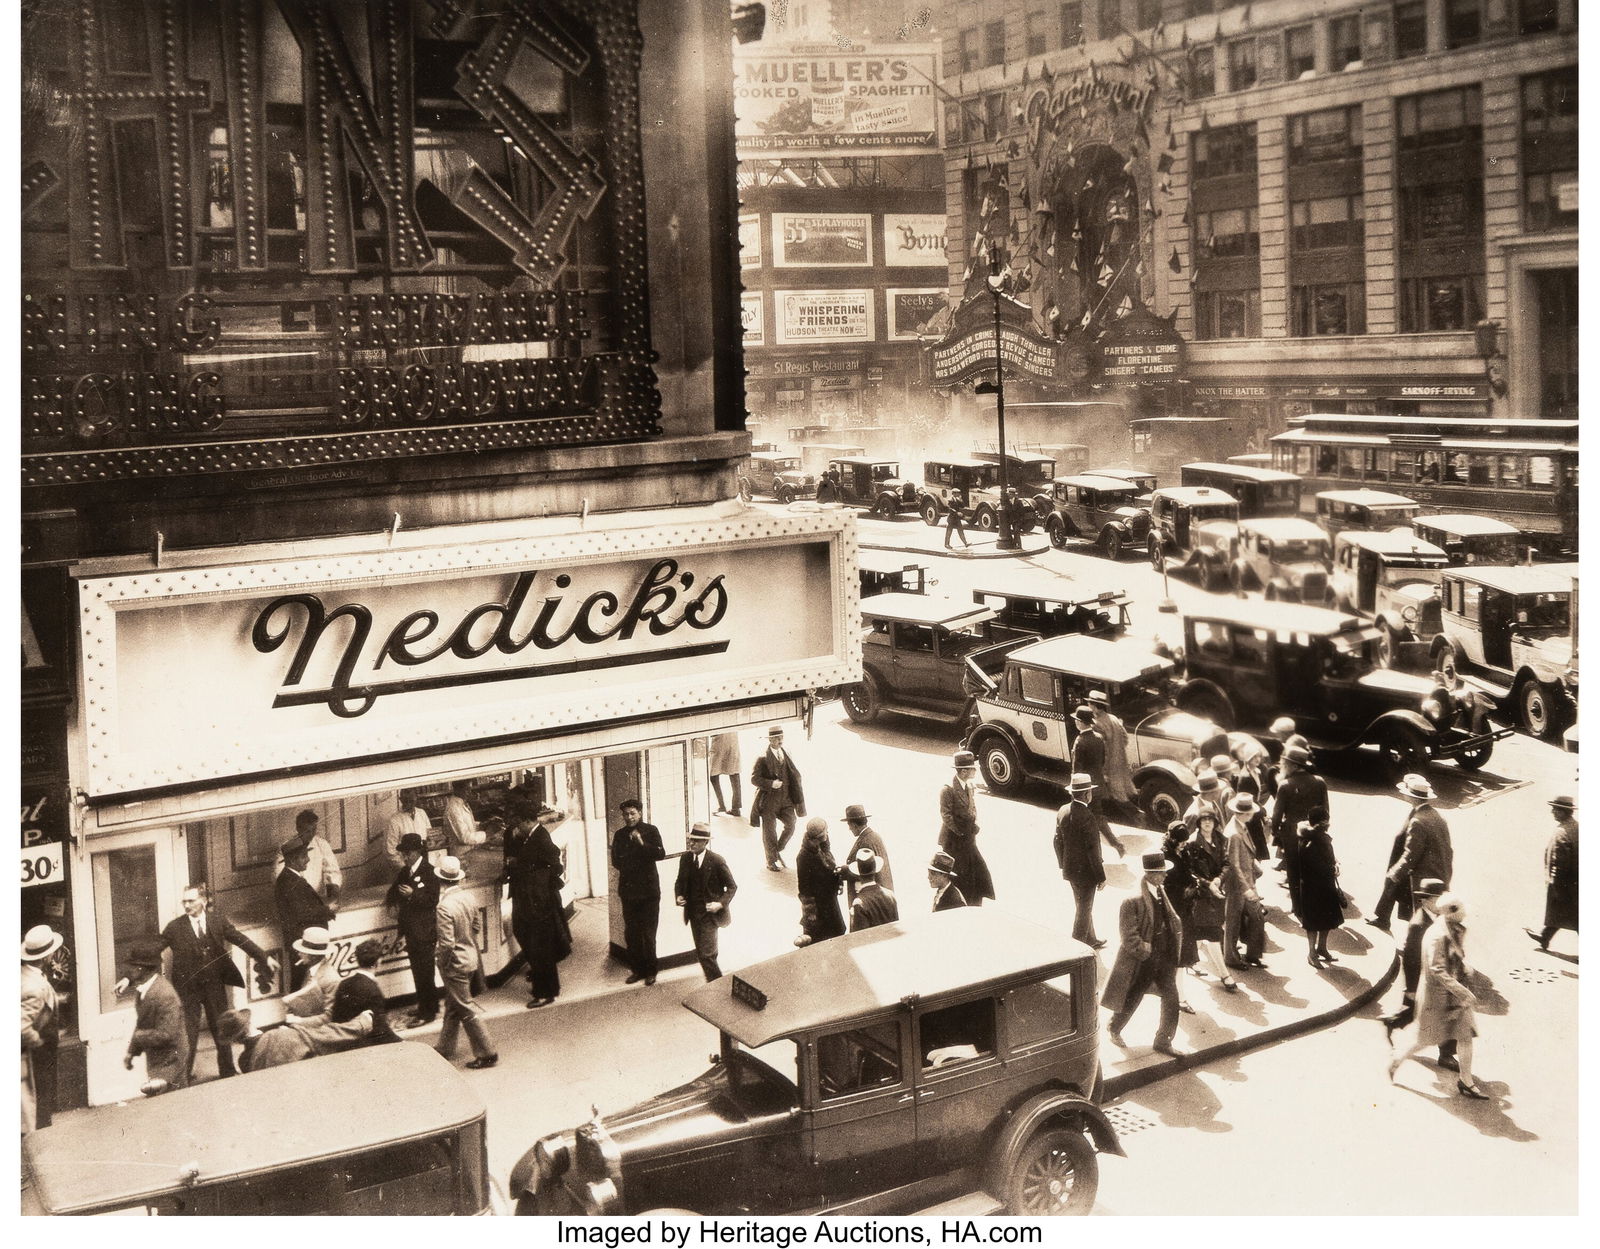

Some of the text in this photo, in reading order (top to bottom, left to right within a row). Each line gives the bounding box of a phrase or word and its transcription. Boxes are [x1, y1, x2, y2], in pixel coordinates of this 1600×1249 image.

[745, 58, 908, 84] MUELLER'S
[737, 84, 930, 99] OOKED SPAGHETTI
[774, 136, 784, 147] is
[787, 135, 820, 147] worth
[823, 137, 830, 145] a
[834, 134, 855, 145] few
[859, 134, 891, 144] cents
[900, 296, 934, 306] Seely's
[799, 305, 865, 315] WHISPERING
[799, 315, 848, 326] FRIENDS
[786, 327, 817, 336] HUDSON
[840, 326, 854, 334] NOW
[934, 330, 1051, 359] PARTNERS IN CRIME AUGH THRILLER
[971, 339, 1003, 353] GORGEOS
[1104, 346, 1144, 355] PARTNERS
[1155, 344, 1177, 353] CRIME
[812, 360, 859, 372] Restaurant
[984, 349, 1022, 366] FLOENTINE
[1024, 361, 1053, 377] SINGERS
[1118, 355, 1162, 365] FLORENTINE
[1104, 366, 1136, 375] SINGERS
[335, 355, 601, 423] BROADWAY
[1219, 387, 1232, 396] THE
[1235, 387, 1265, 396] HATTER
[251, 557, 729, 719] Nedick's
